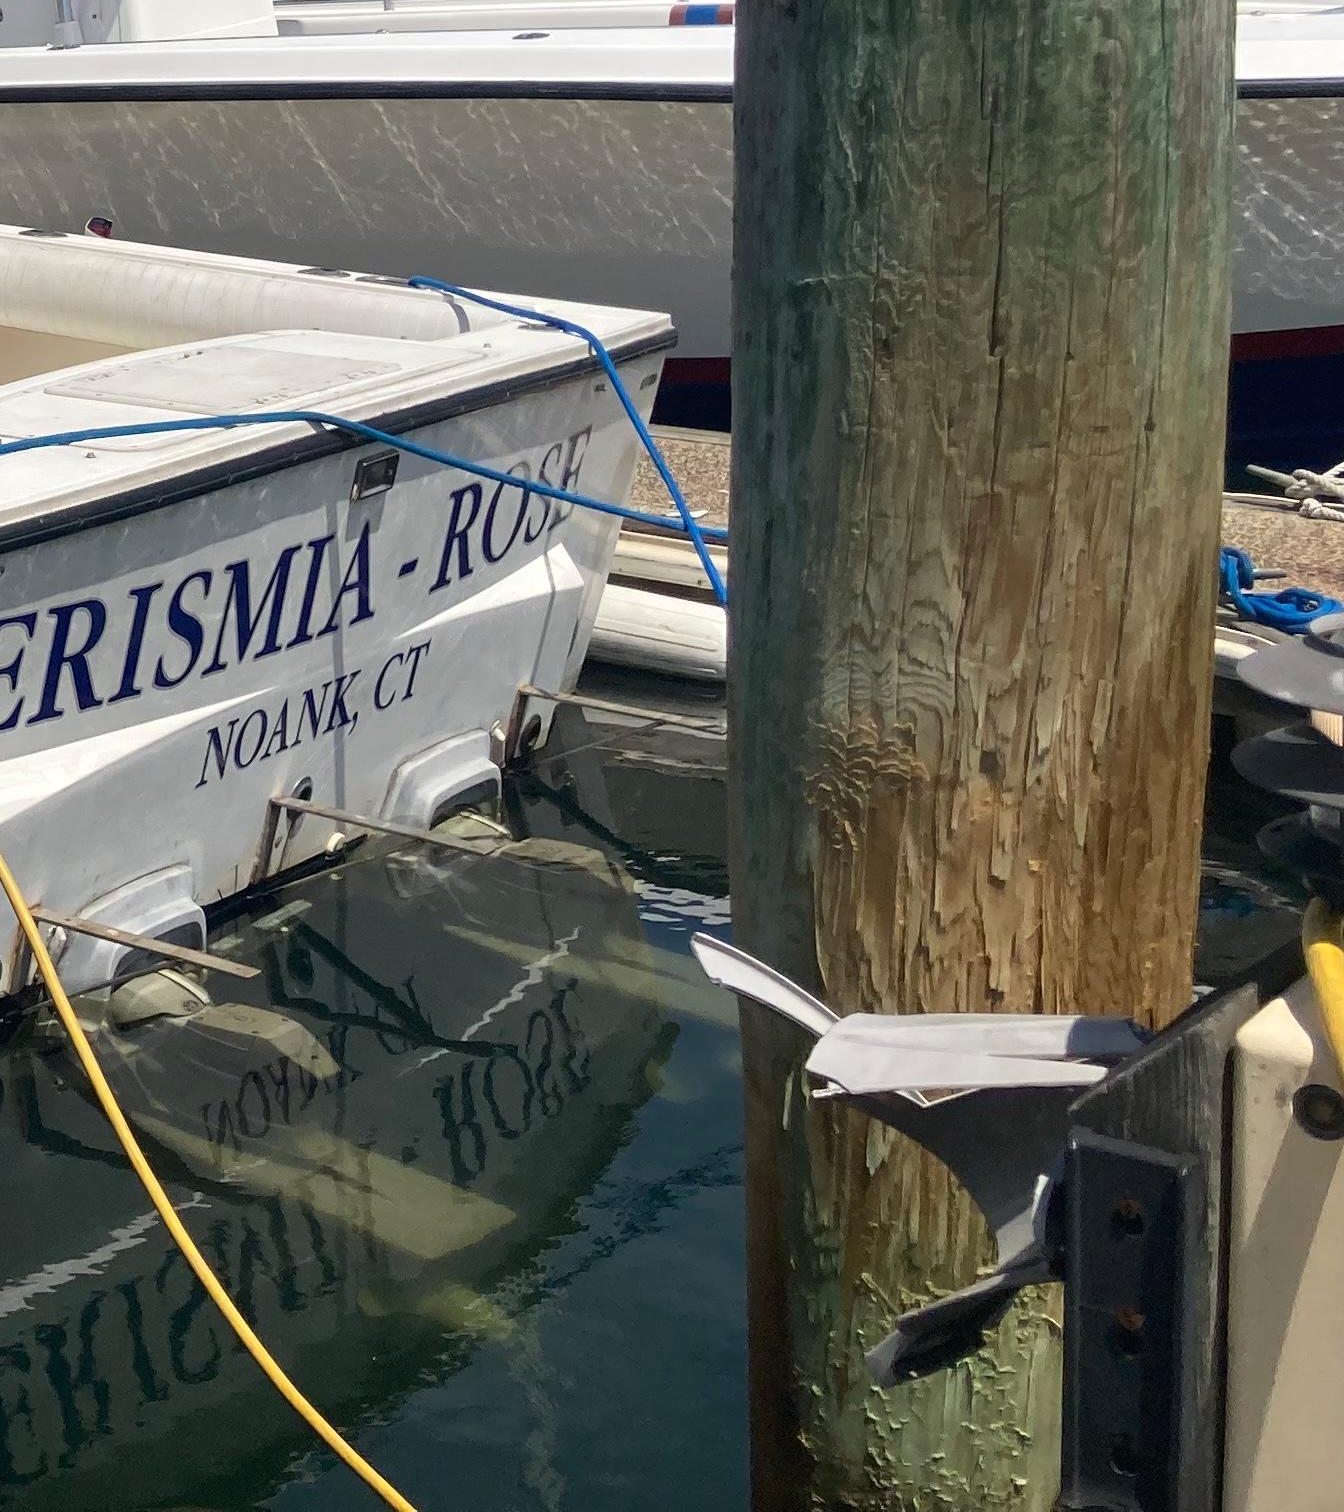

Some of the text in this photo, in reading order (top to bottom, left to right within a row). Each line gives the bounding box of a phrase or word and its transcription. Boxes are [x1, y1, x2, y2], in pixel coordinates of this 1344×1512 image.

[428, 424, 593, 593] ROSE
[195, 638, 432, 790] NOANK, CT
